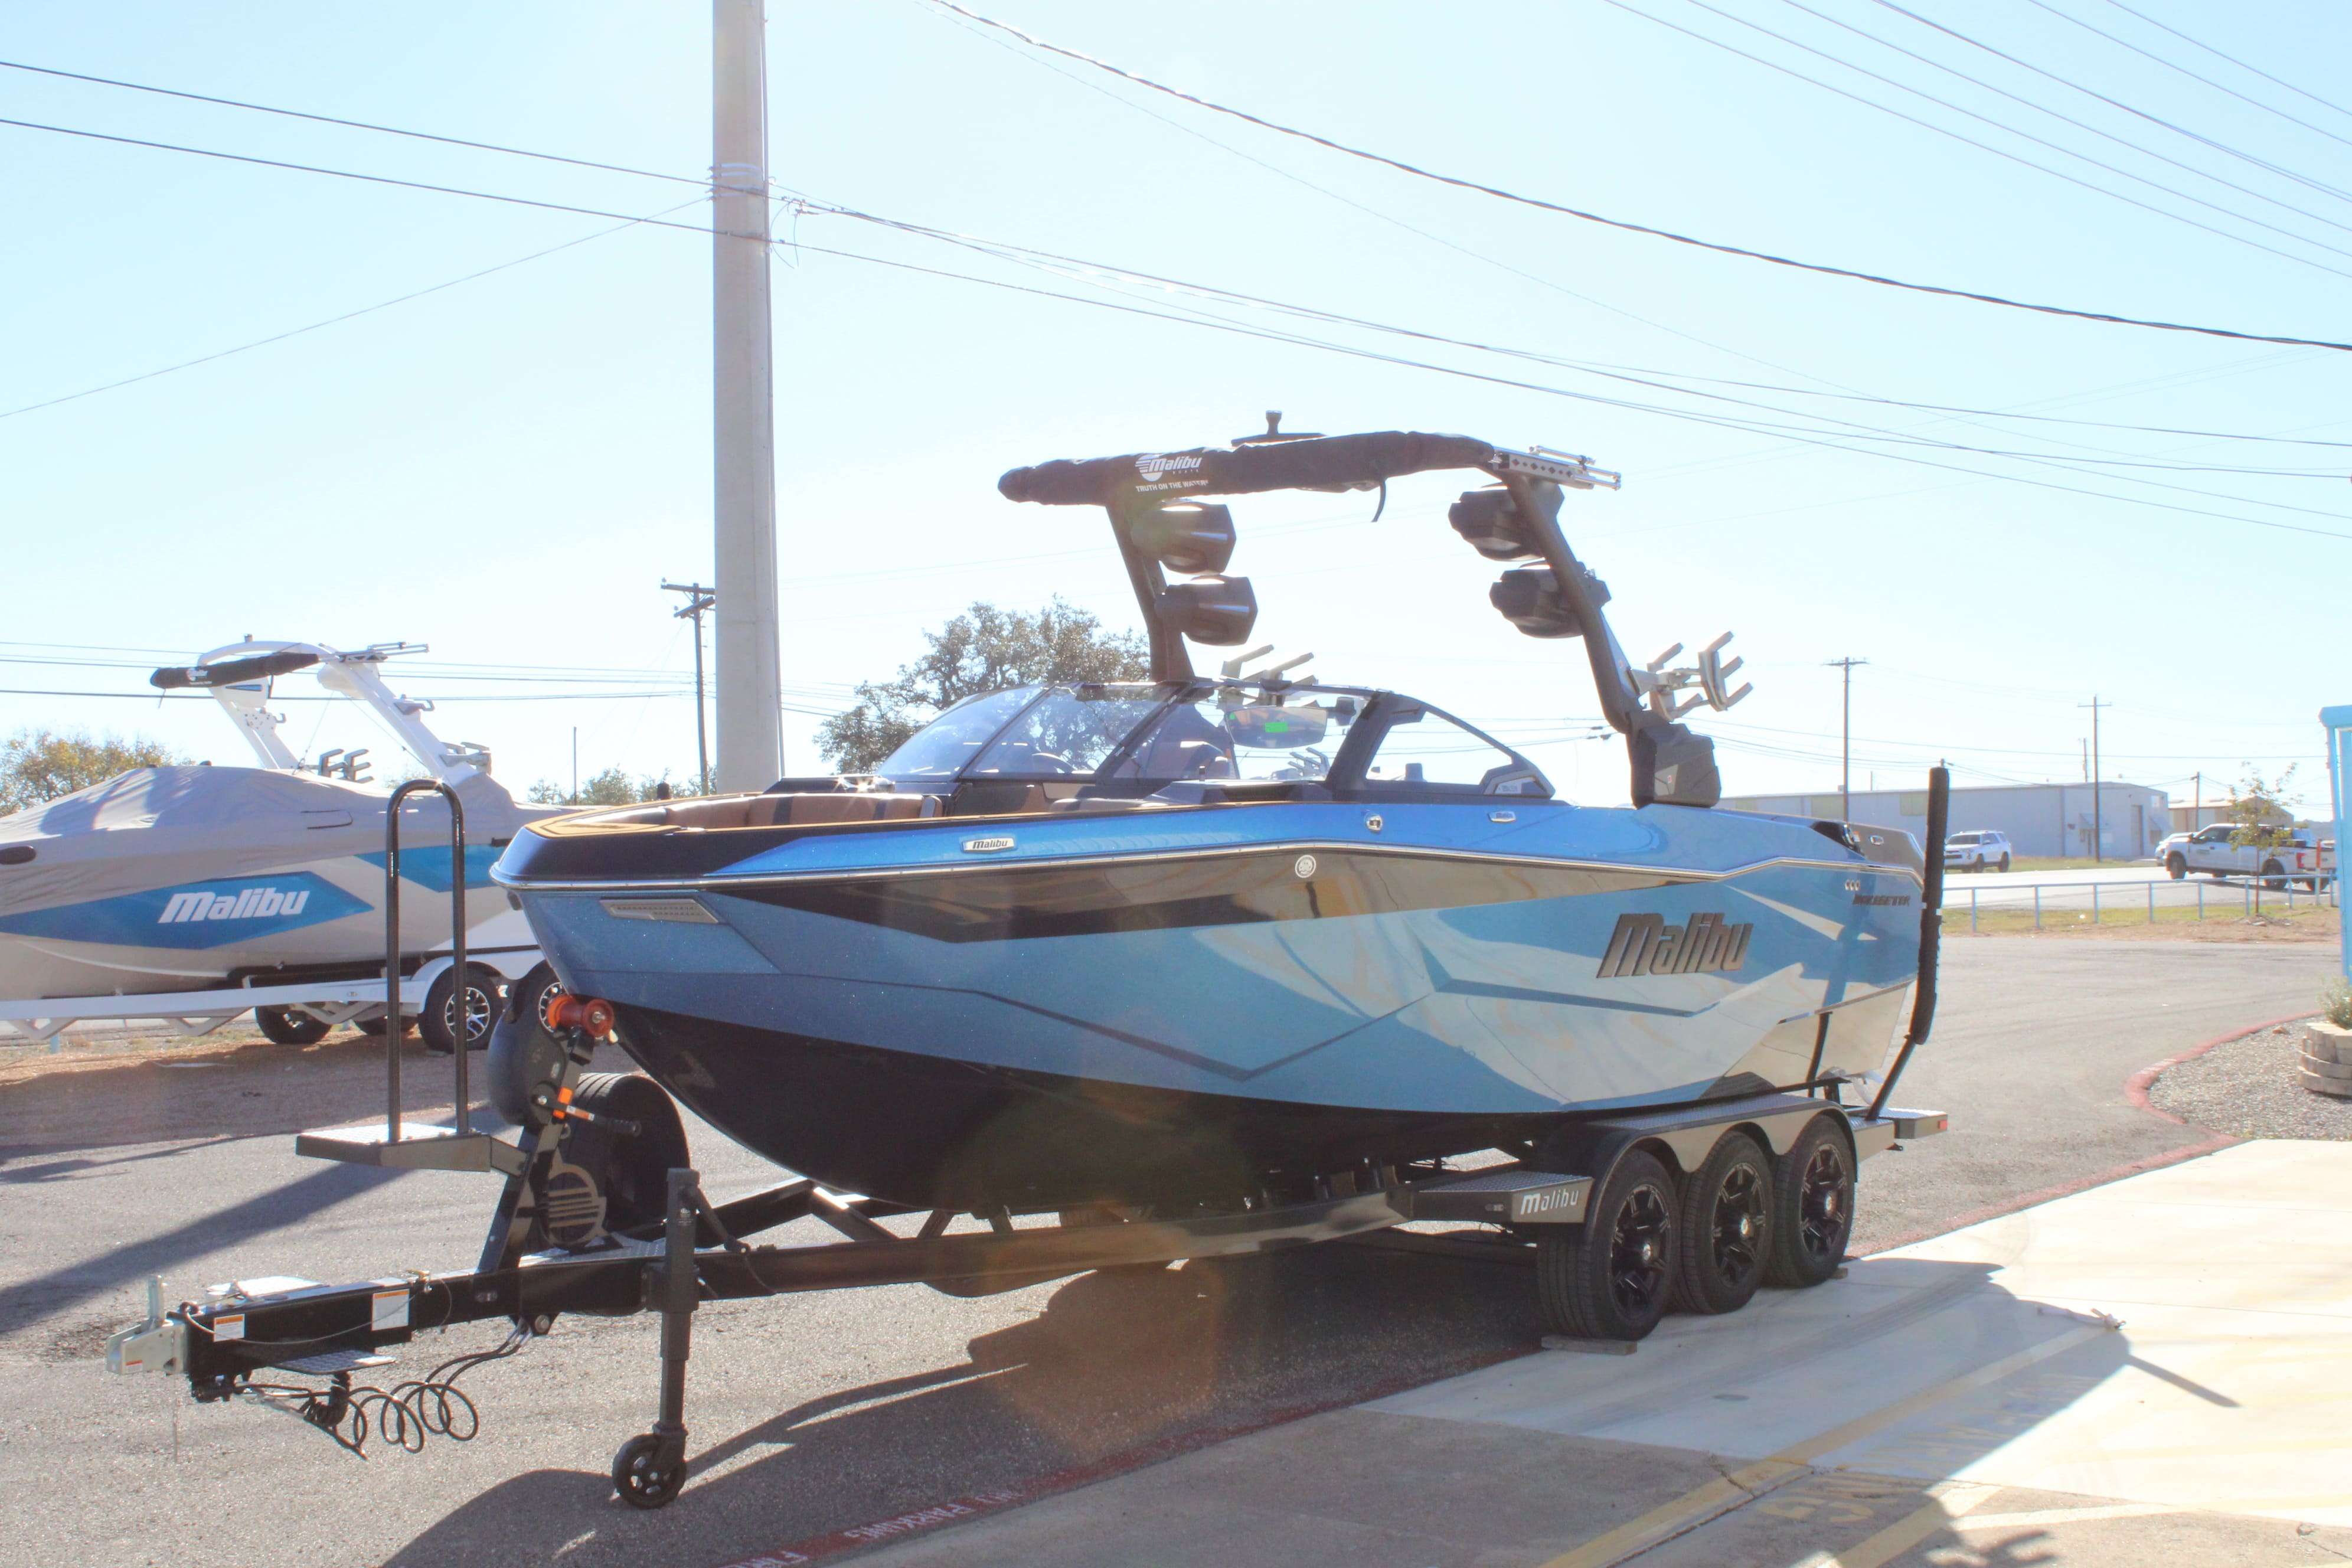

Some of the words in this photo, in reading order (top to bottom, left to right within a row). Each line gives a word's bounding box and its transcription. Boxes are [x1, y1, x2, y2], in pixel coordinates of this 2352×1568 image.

[1149, 456, 1203, 472] Malibu
[1136, 484, 1158, 492] TRUTH
[158, 887, 310, 923] Malibu
[1596, 912, 1754, 978] Malibu
